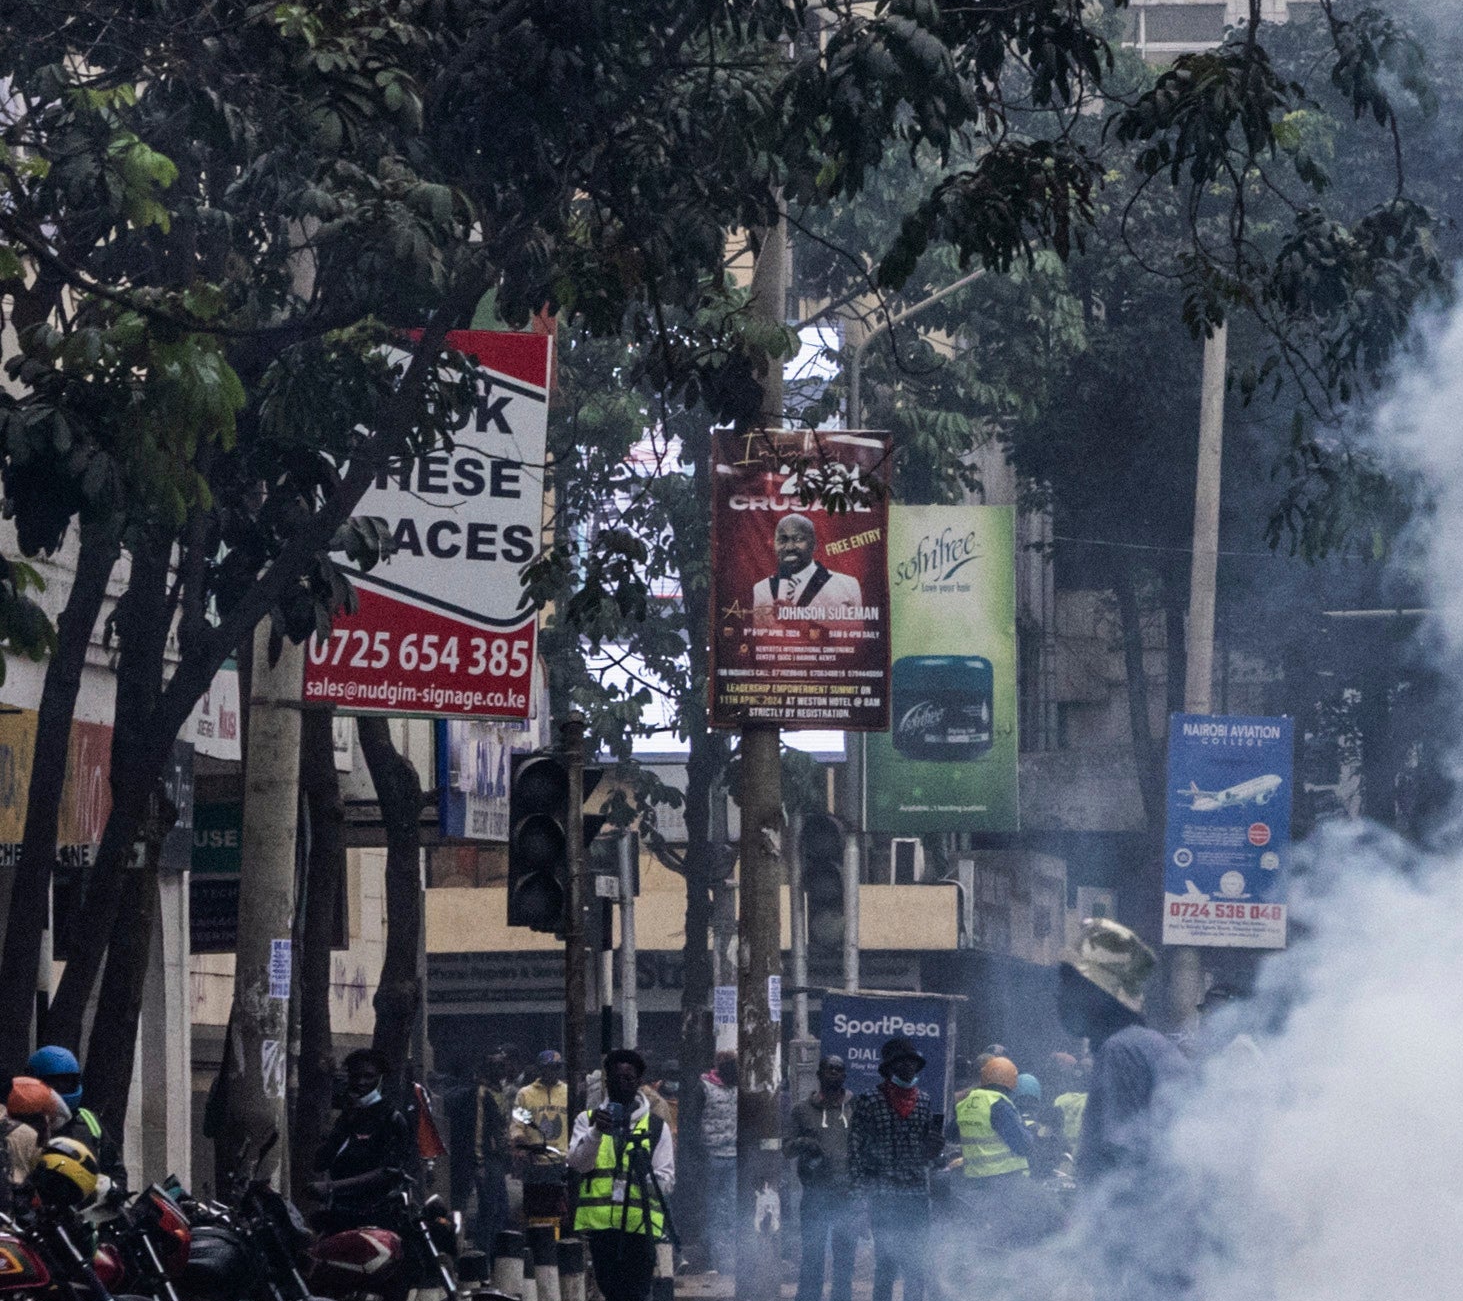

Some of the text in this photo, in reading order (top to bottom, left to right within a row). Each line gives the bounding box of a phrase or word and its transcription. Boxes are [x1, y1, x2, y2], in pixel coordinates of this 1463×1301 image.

[374, 454, 521, 499] HESE
[728, 496, 872, 513] CRUSAE
[825, 528, 882, 556] FREE ENTRY
[777, 606, 825, 621] JOHNSON
[828, 606, 879, 621] SULEMAN
[308, 629, 530, 678] 0725 654 385
[306, 677, 526, 710] sales@nudgim-signage.co.ke
[726, 683, 770, 693] LEADERSHIP
[772, 684, 829, 694] EMPOWERMENT
[830, 686, 860, 695] SUMMIT
[786, 697, 796, 705] AT
[829, 698, 852, 707] HOTEL
[749, 708, 784, 718] STRICTLY
[785, 708, 796, 717] BY
[1183, 723, 1281, 739] NAIROBI AVIATION
[1201, 737, 1263, 746] COLLEGE
[194, 830, 238, 847] USE
[1169, 902, 1282, 921] 0724 536 048
[833, 1014, 940, 1038] SportPesa
[847, 1047, 881, 1061] DIAL
